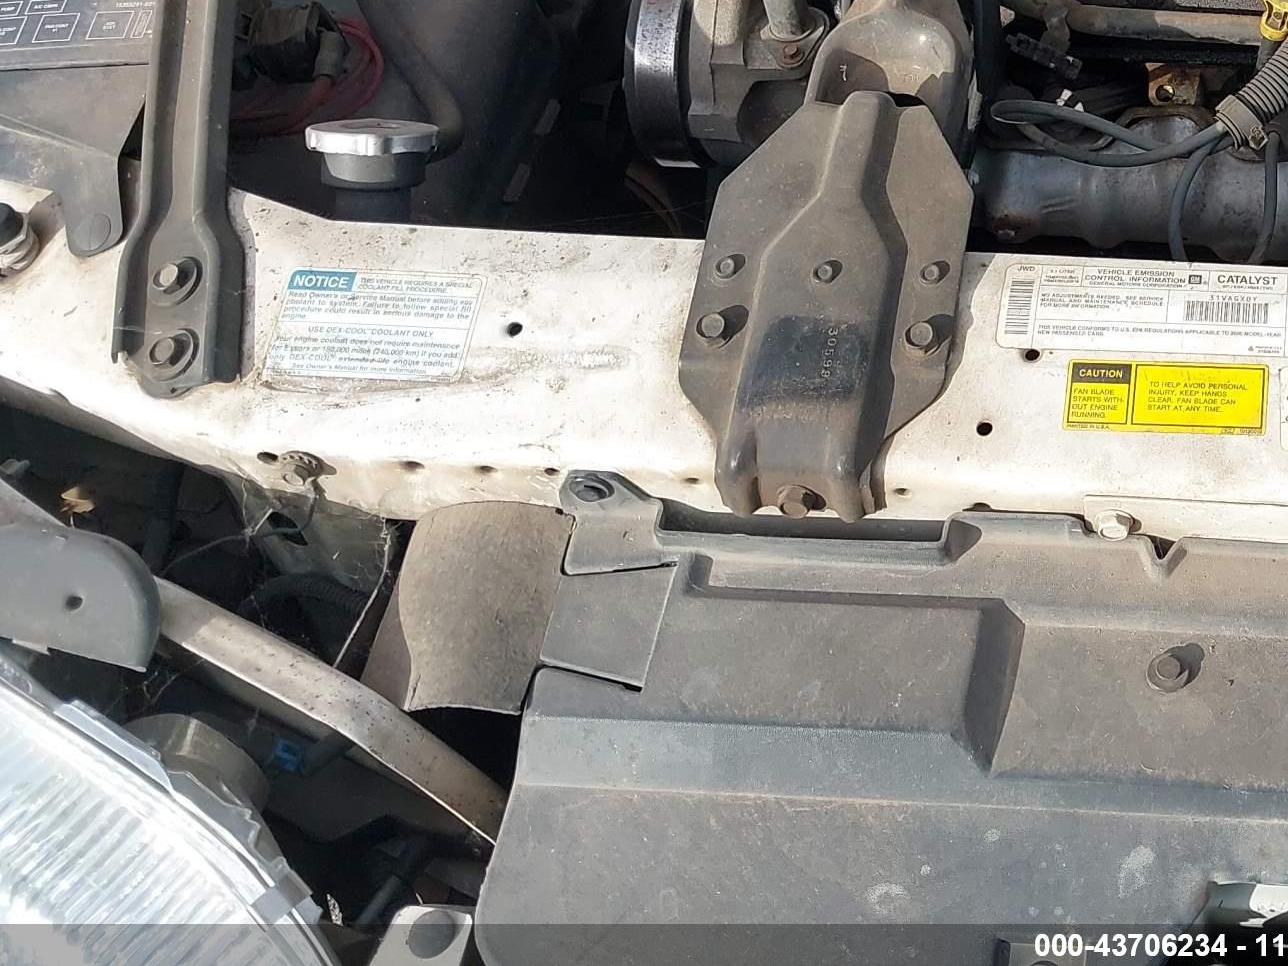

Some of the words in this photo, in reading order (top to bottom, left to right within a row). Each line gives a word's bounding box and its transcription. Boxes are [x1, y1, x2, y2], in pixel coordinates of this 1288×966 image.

[1097, 268, 1134, 276] VEHICLE
[1134, 269, 1176, 277] EMISSION
[293, 274, 351, 289] NOTICE
[1085, 274, 1125, 282] CONTROL
[1129, 276, 1186, 284] INFORMATION
[1216, 274, 1278, 285] CATALYST
[820, 328, 839, 379] 30599
[1078, 368, 1124, 379] CAUTION
[1161, 381, 1181, 389] HELP
[1182, 382, 1206, 390] AVOID
[1208, 382, 1248, 391] PERSONAL
[1090, 388, 1116, 396] BLADE
[1179, 389, 1200, 397] KEEP
[1201, 390, 1227, 398] HANDS
[1072, 395, 1101, 403] STARTS
[1176, 397, 1192, 405] FAN
[1193, 397, 1218, 406] BLADE
[1220, 398, 1237, 406] CAN
[1147, 404, 1171, 412] START
[1184, 405, 1202, 413] ANY
